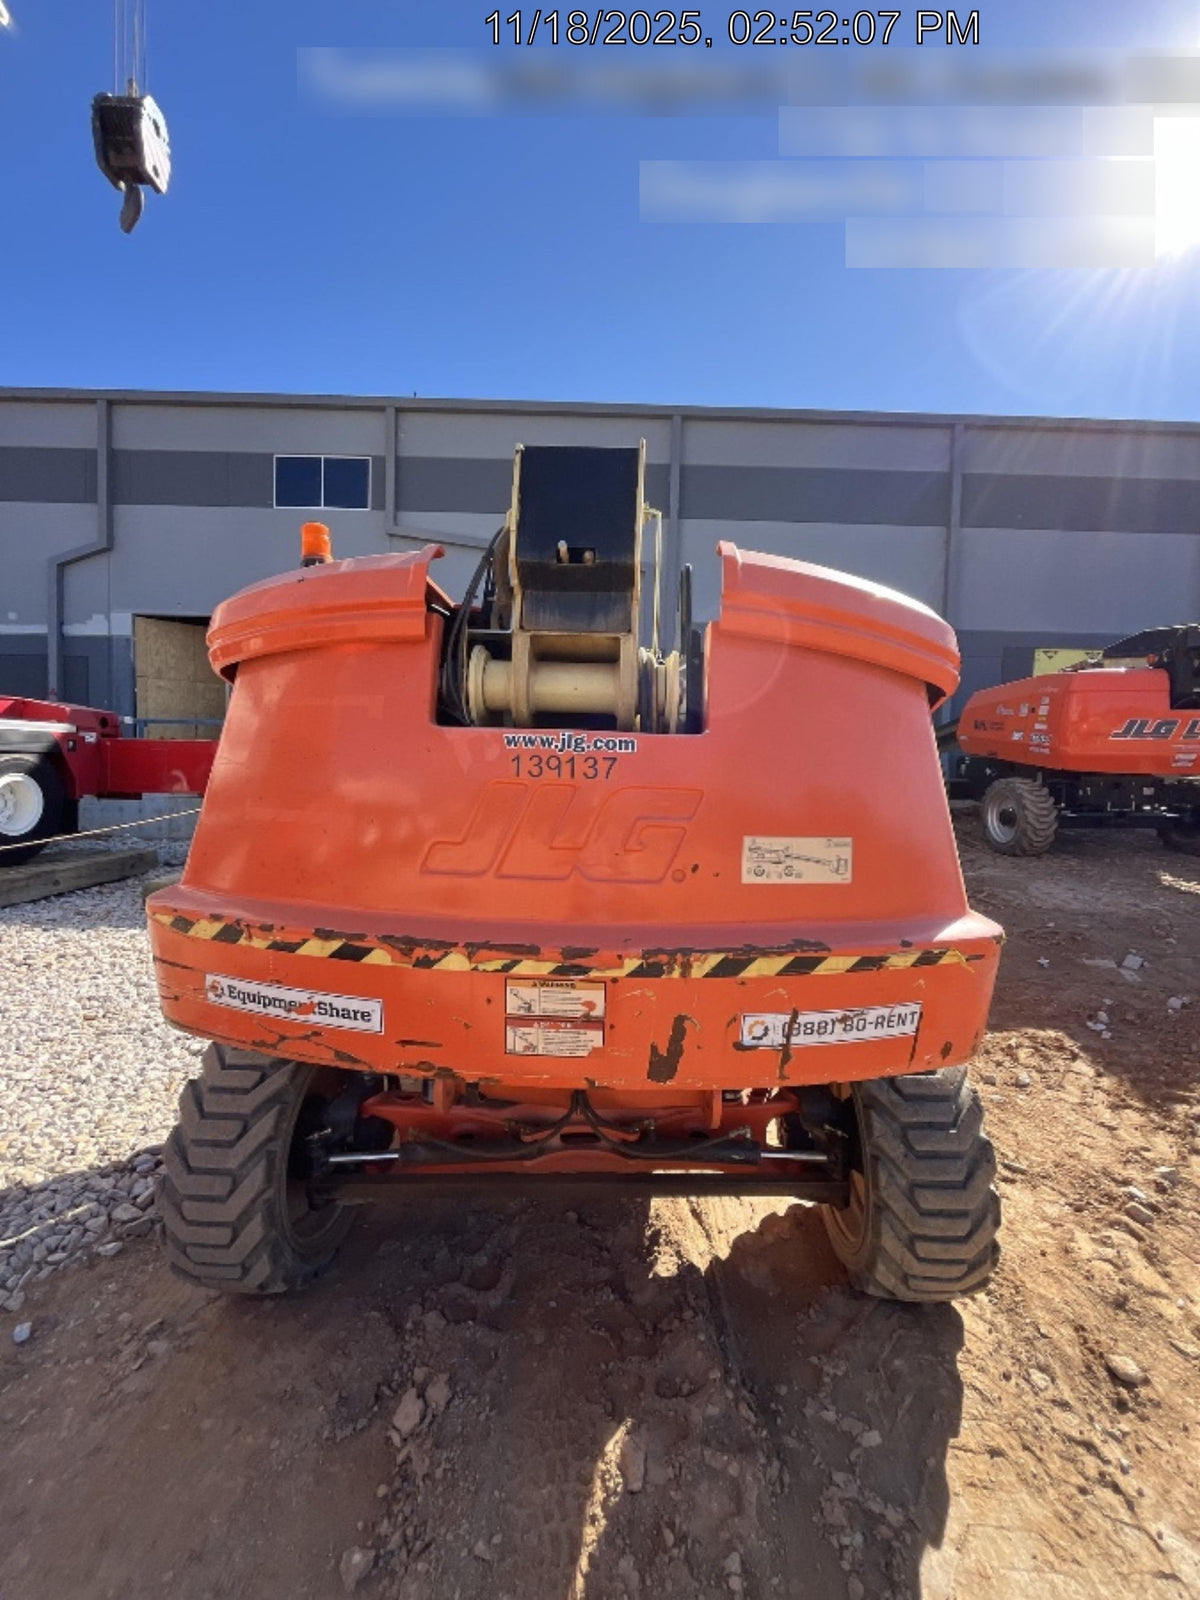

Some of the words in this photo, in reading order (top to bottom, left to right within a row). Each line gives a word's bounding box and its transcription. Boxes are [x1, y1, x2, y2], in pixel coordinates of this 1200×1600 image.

[1109, 718, 1182, 740] JLG
[503, 732, 637, 752] www.jlg.com
[511, 754, 618, 779] 139137
